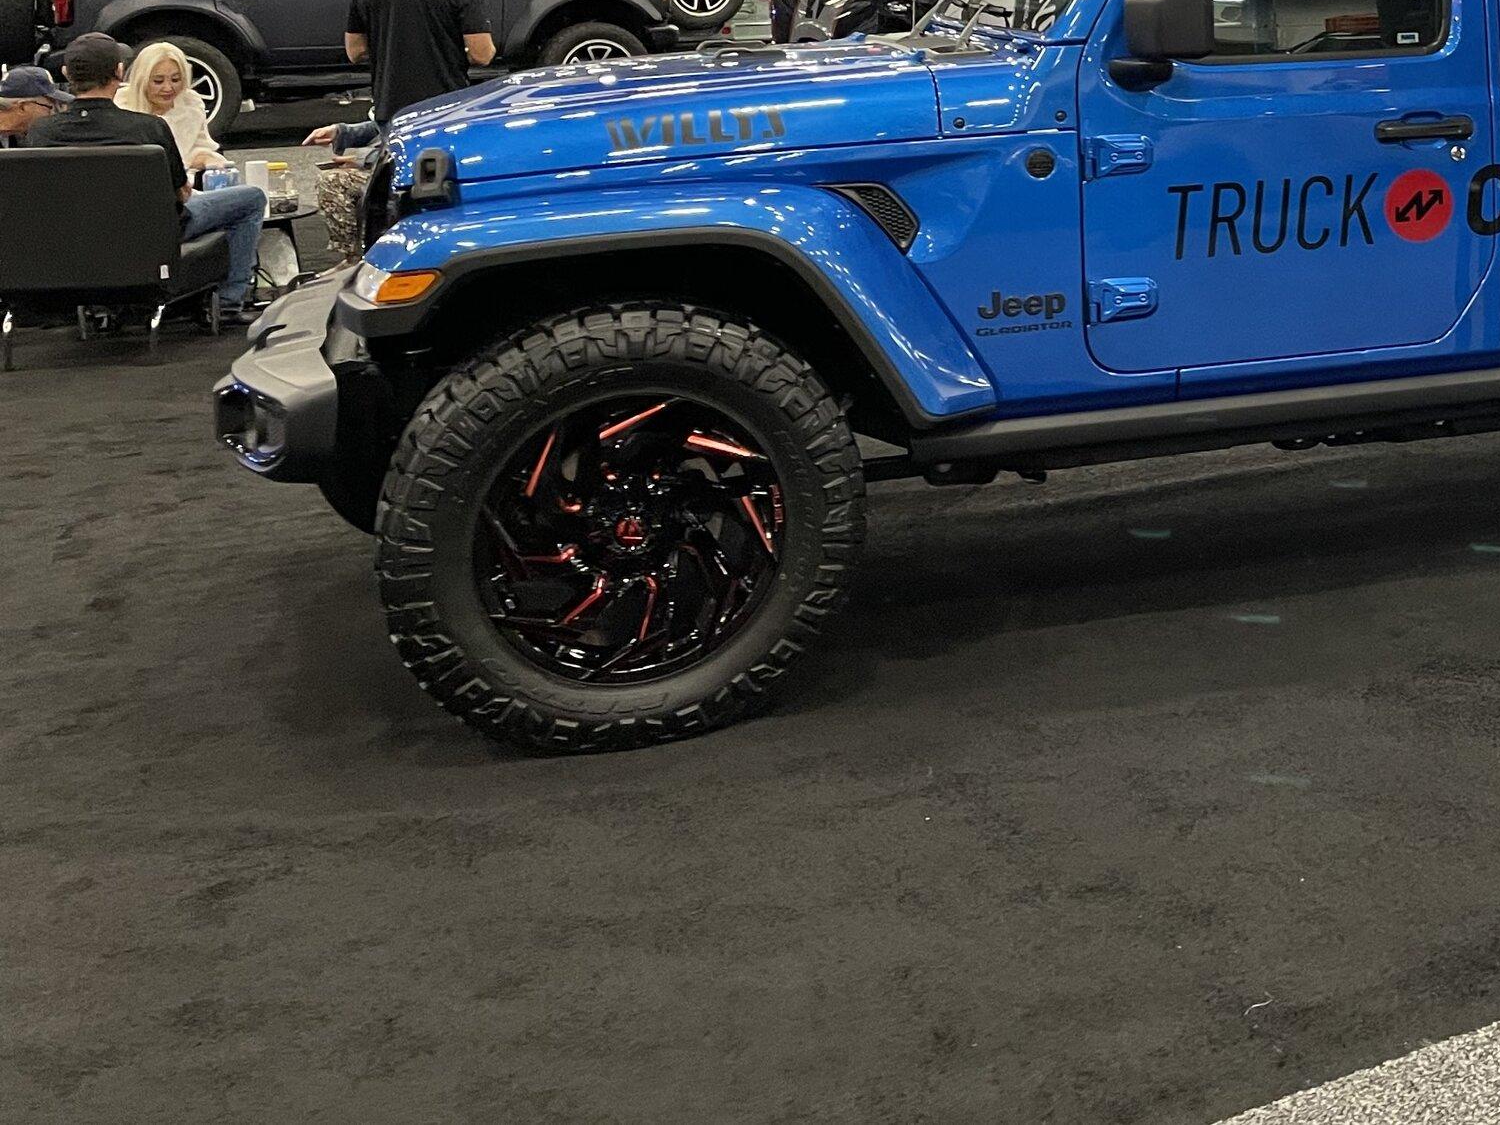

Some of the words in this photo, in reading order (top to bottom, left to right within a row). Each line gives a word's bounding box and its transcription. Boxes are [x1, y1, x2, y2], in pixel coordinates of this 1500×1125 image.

[607, 107, 786, 152] WILLYS
[1168, 173, 1379, 261] TRUCK
[977, 291, 1066, 320] Jeep
[976, 321, 1072, 336] GLADIATOR
